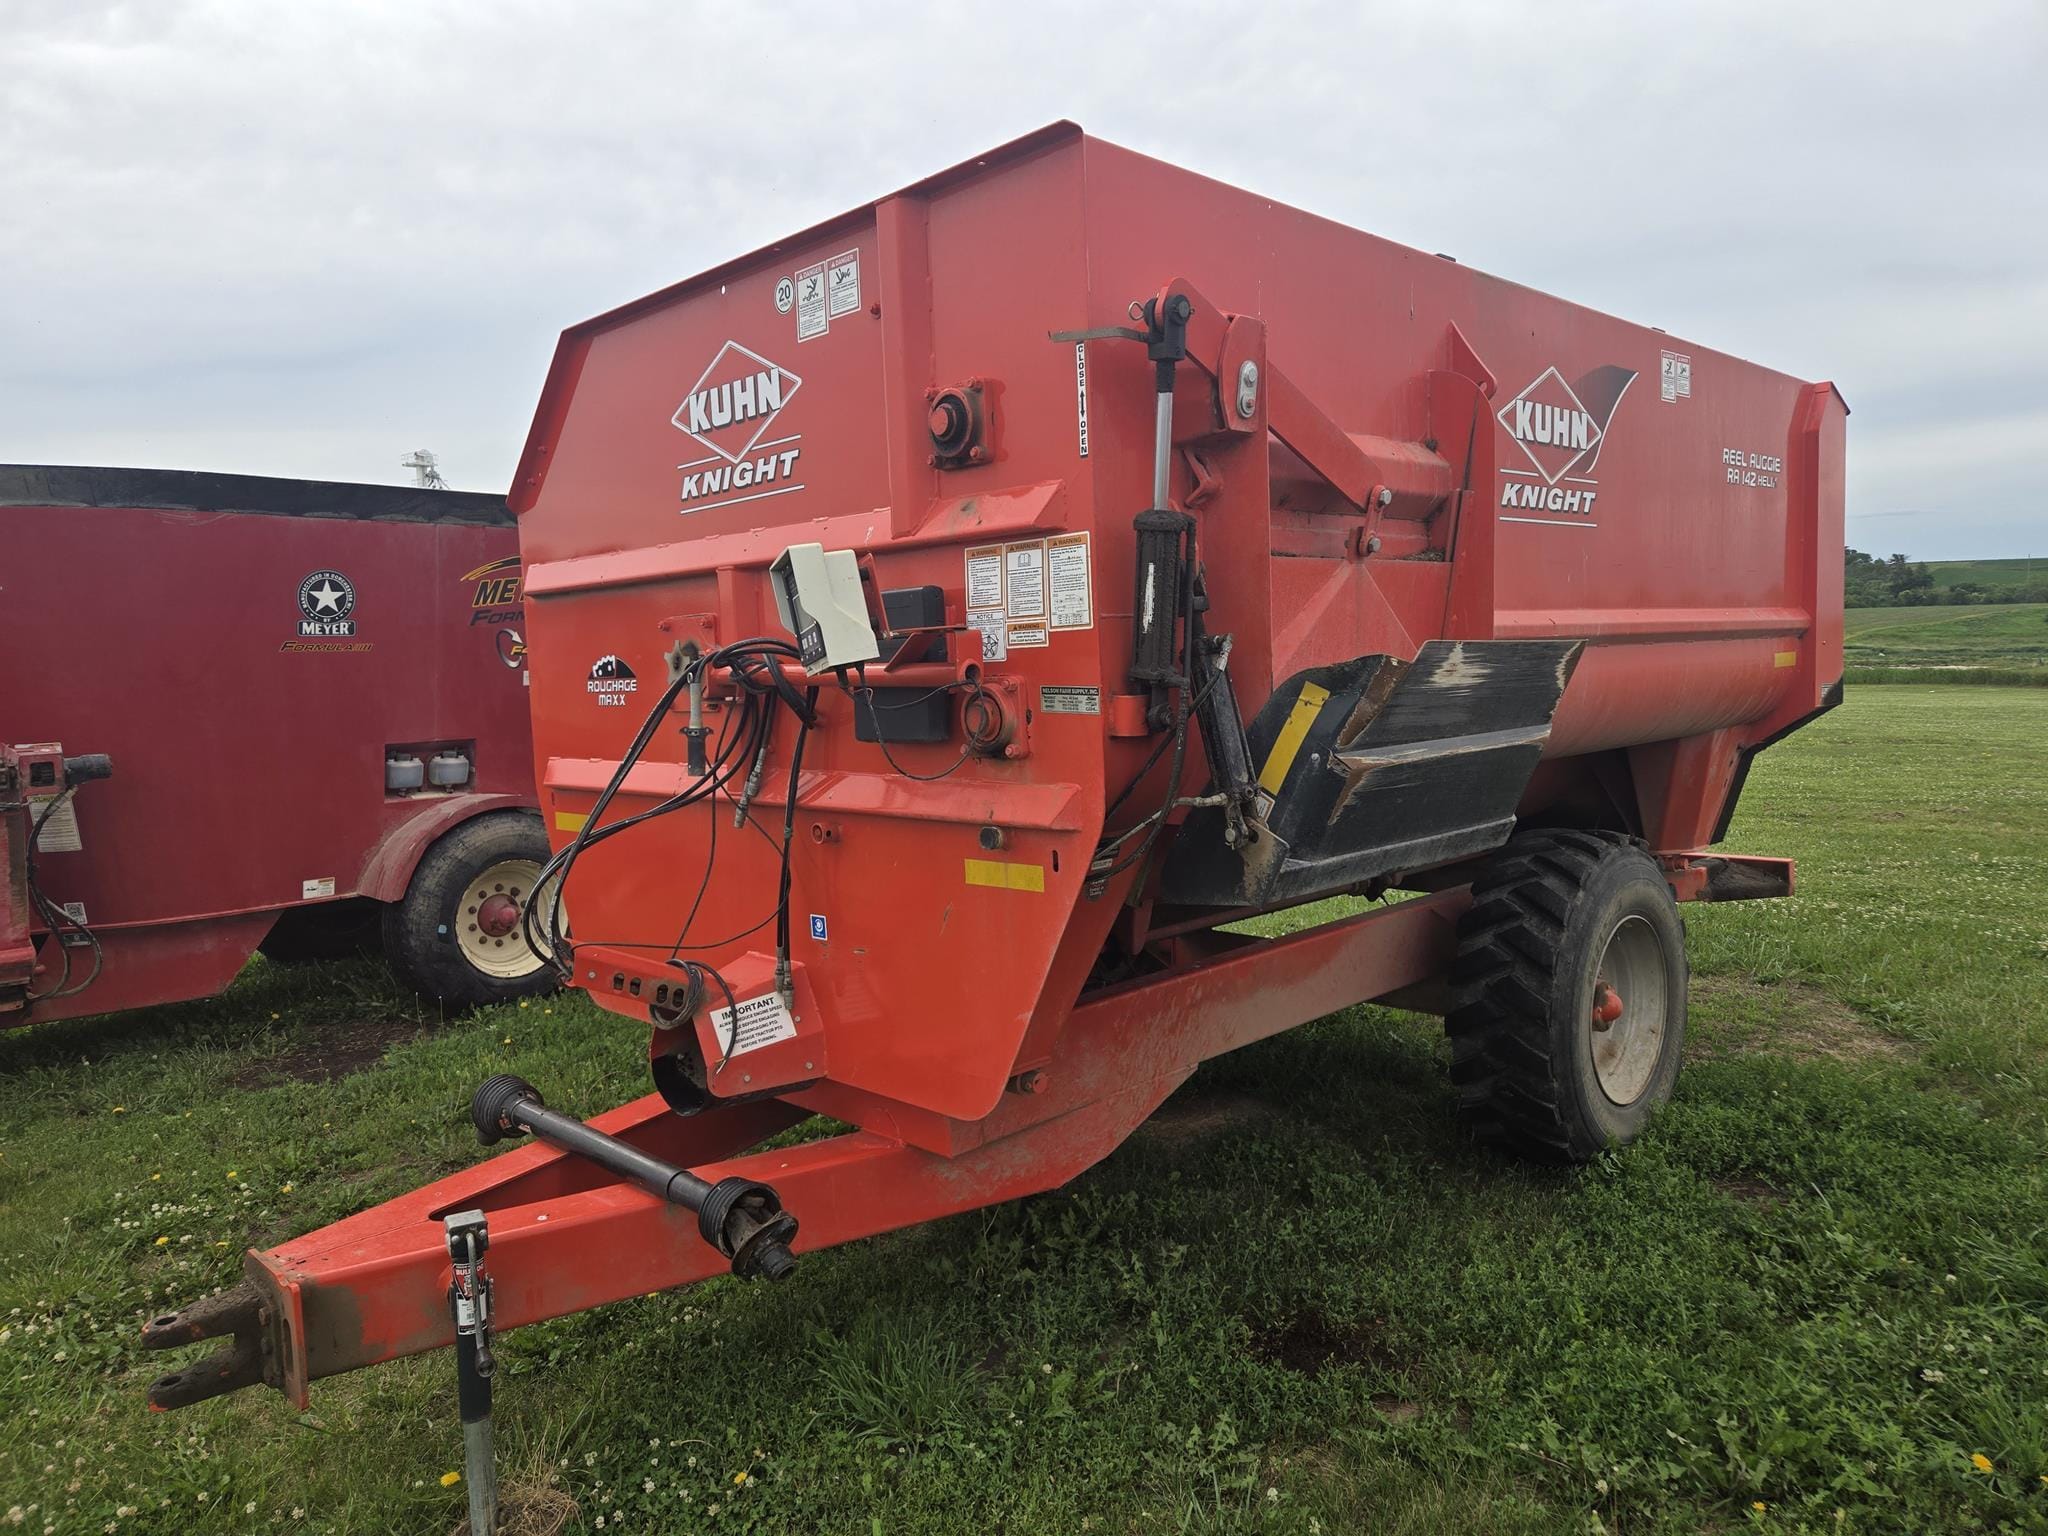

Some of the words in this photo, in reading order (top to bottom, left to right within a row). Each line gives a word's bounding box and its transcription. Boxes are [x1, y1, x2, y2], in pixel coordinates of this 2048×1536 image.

[778, 284, 791, 302] 20
[1077, 345, 1085, 387] CLOSE
[688, 367, 781, 434] KUHN
[1515, 399, 1588, 450] KUHN
[1723, 448, 1747, 467] REEL
[1750, 453, 1781, 473] AUGGIE
[681, 449, 800, 500] KNIGHT
[1727, 468, 1740, 484] RA
[1742, 470, 1757, 487] 142
[1501, 483, 1596, 514] KNIGHT
[472, 577, 524, 607] ME
[302, 622, 349, 635] MEYER
[587, 679, 637, 692] ROUGHAGE
[598, 694, 626, 706] MAXX
[769, 1004, 783, 1013] SPEED
[742, 1019, 758, 1028] BEFORE
[741, 1041, 758, 1049] BEFORE
